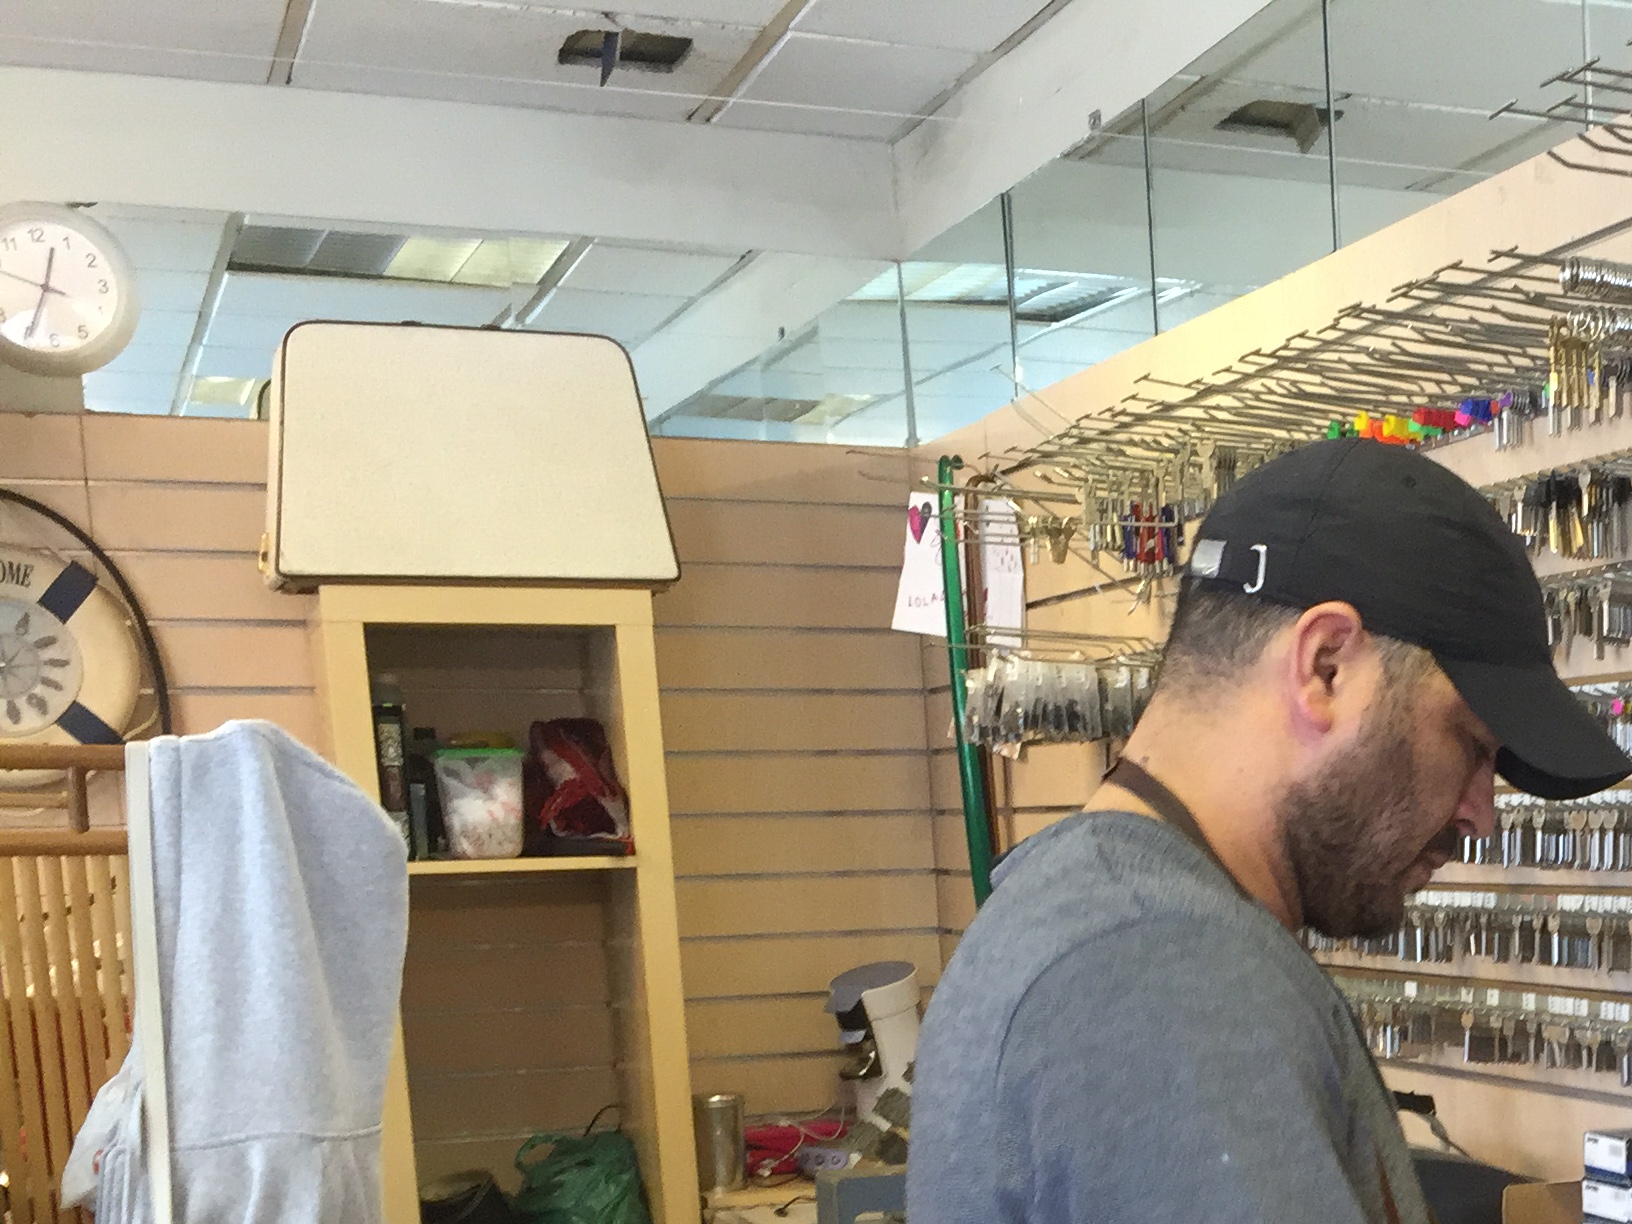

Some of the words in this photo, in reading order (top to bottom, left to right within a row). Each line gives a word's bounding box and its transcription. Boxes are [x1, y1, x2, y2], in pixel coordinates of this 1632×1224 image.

[27, 228, 45, 243] 12
[63, 236, 71, 250] 1
[1, 237, 17, 251] 11
[86, 253, 97, 268] 2
[98, 279, 109, 294] 3
[78, 325, 89, 340] 5
[50, 334, 60, 348] 6
